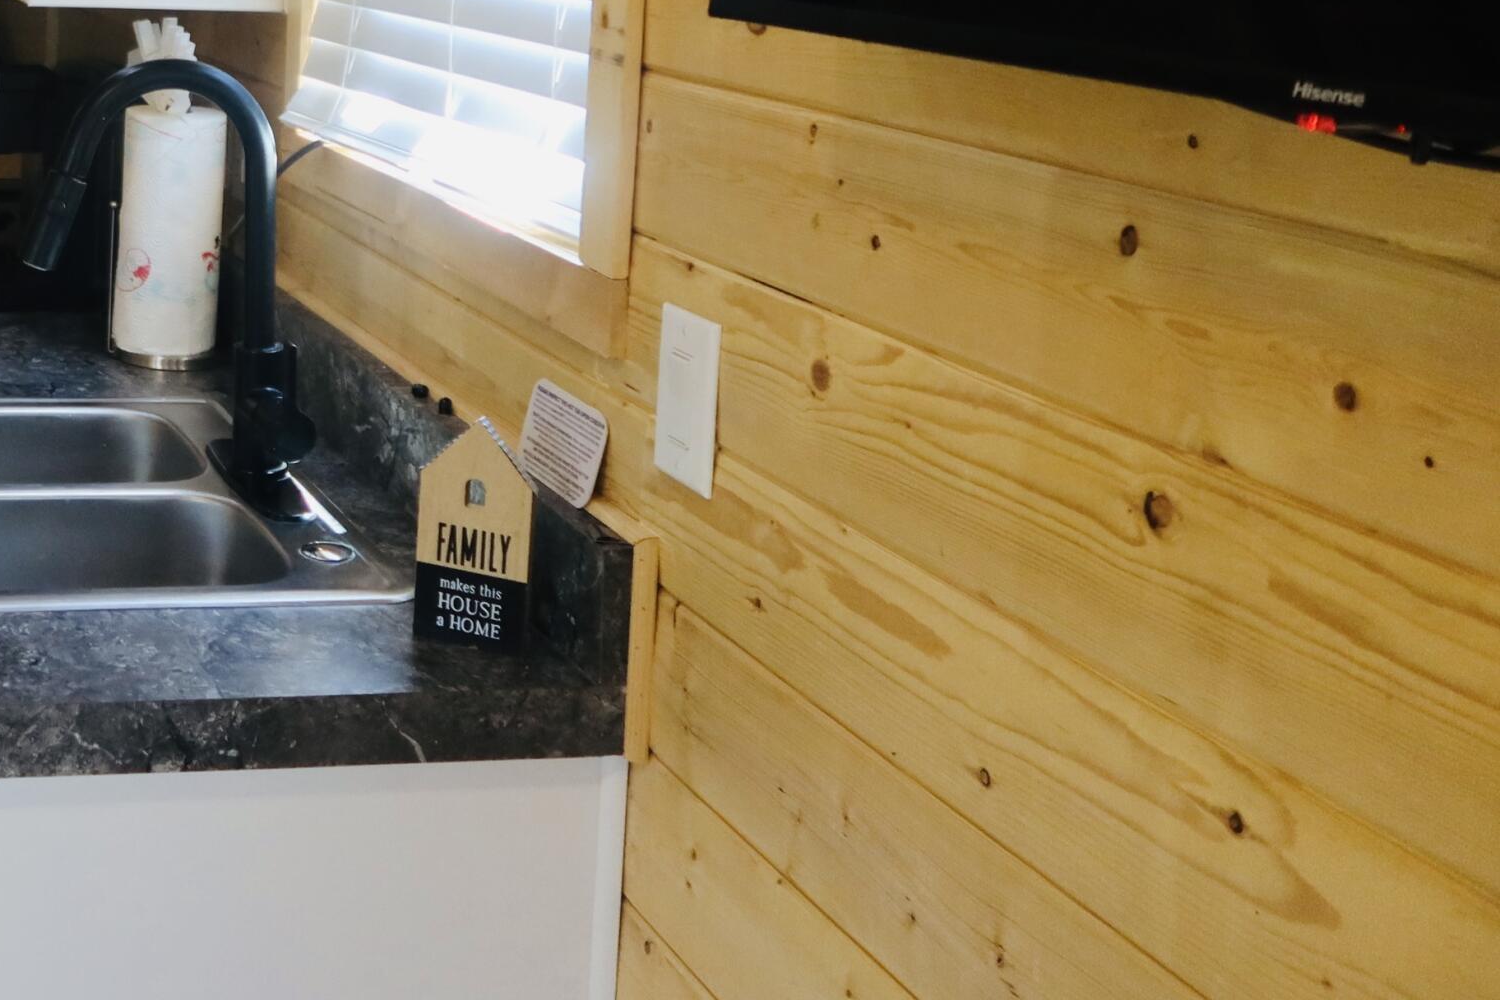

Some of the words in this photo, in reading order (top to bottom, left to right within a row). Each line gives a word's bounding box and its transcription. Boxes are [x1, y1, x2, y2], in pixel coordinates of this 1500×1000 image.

[1293, 81, 1365, 108] Hisense
[437, 522, 511, 574] FAMILY
[440, 578, 476, 595] makes
[480, 584, 502, 600] this
[438, 592, 502, 621] HOUSE
[436, 615, 444, 626] a
[449, 614, 501, 640] HOME
